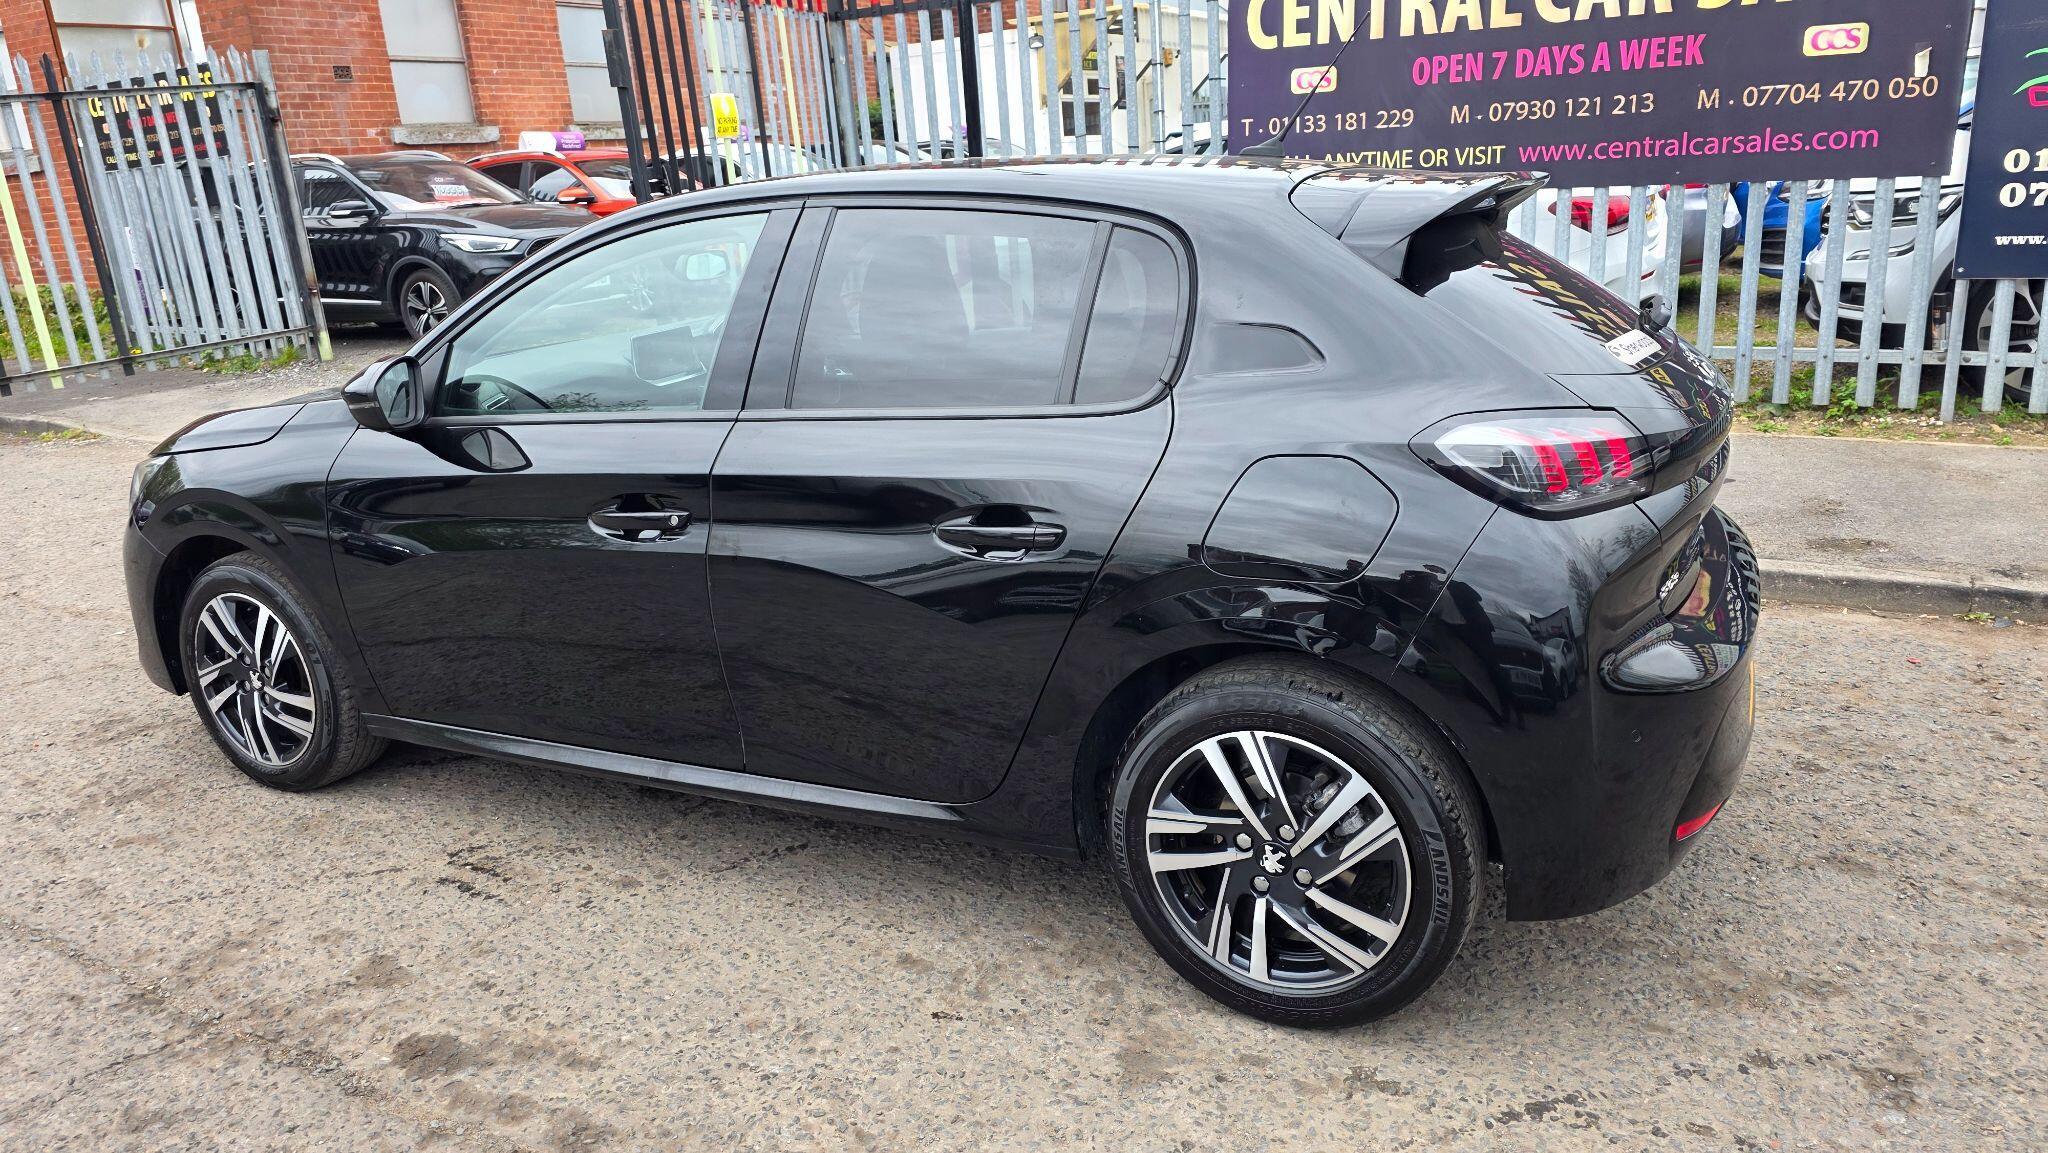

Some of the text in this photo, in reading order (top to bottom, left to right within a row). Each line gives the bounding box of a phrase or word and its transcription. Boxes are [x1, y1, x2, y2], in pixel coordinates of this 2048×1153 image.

[1412, 33, 1707, 86] OPEN 7 DAYS A WEEK
[1489, 99, 1556, 122] 07930
[1565, 96, 1601, 117] 121
[1611, 92, 1655, 115] 213
[1742, 82, 1821, 107] 07704
[1830, 78, 1880, 102] 470
[1888, 75, 1939, 99] 050
[1334, 112, 1367, 130] 181
[1375, 109, 1414, 129] 229
[1419, 148, 1448, 168] OR
[1455, 145, 1506, 166] VISIT
[1518, 127, 1879, 163] www.centralcarsales.com
